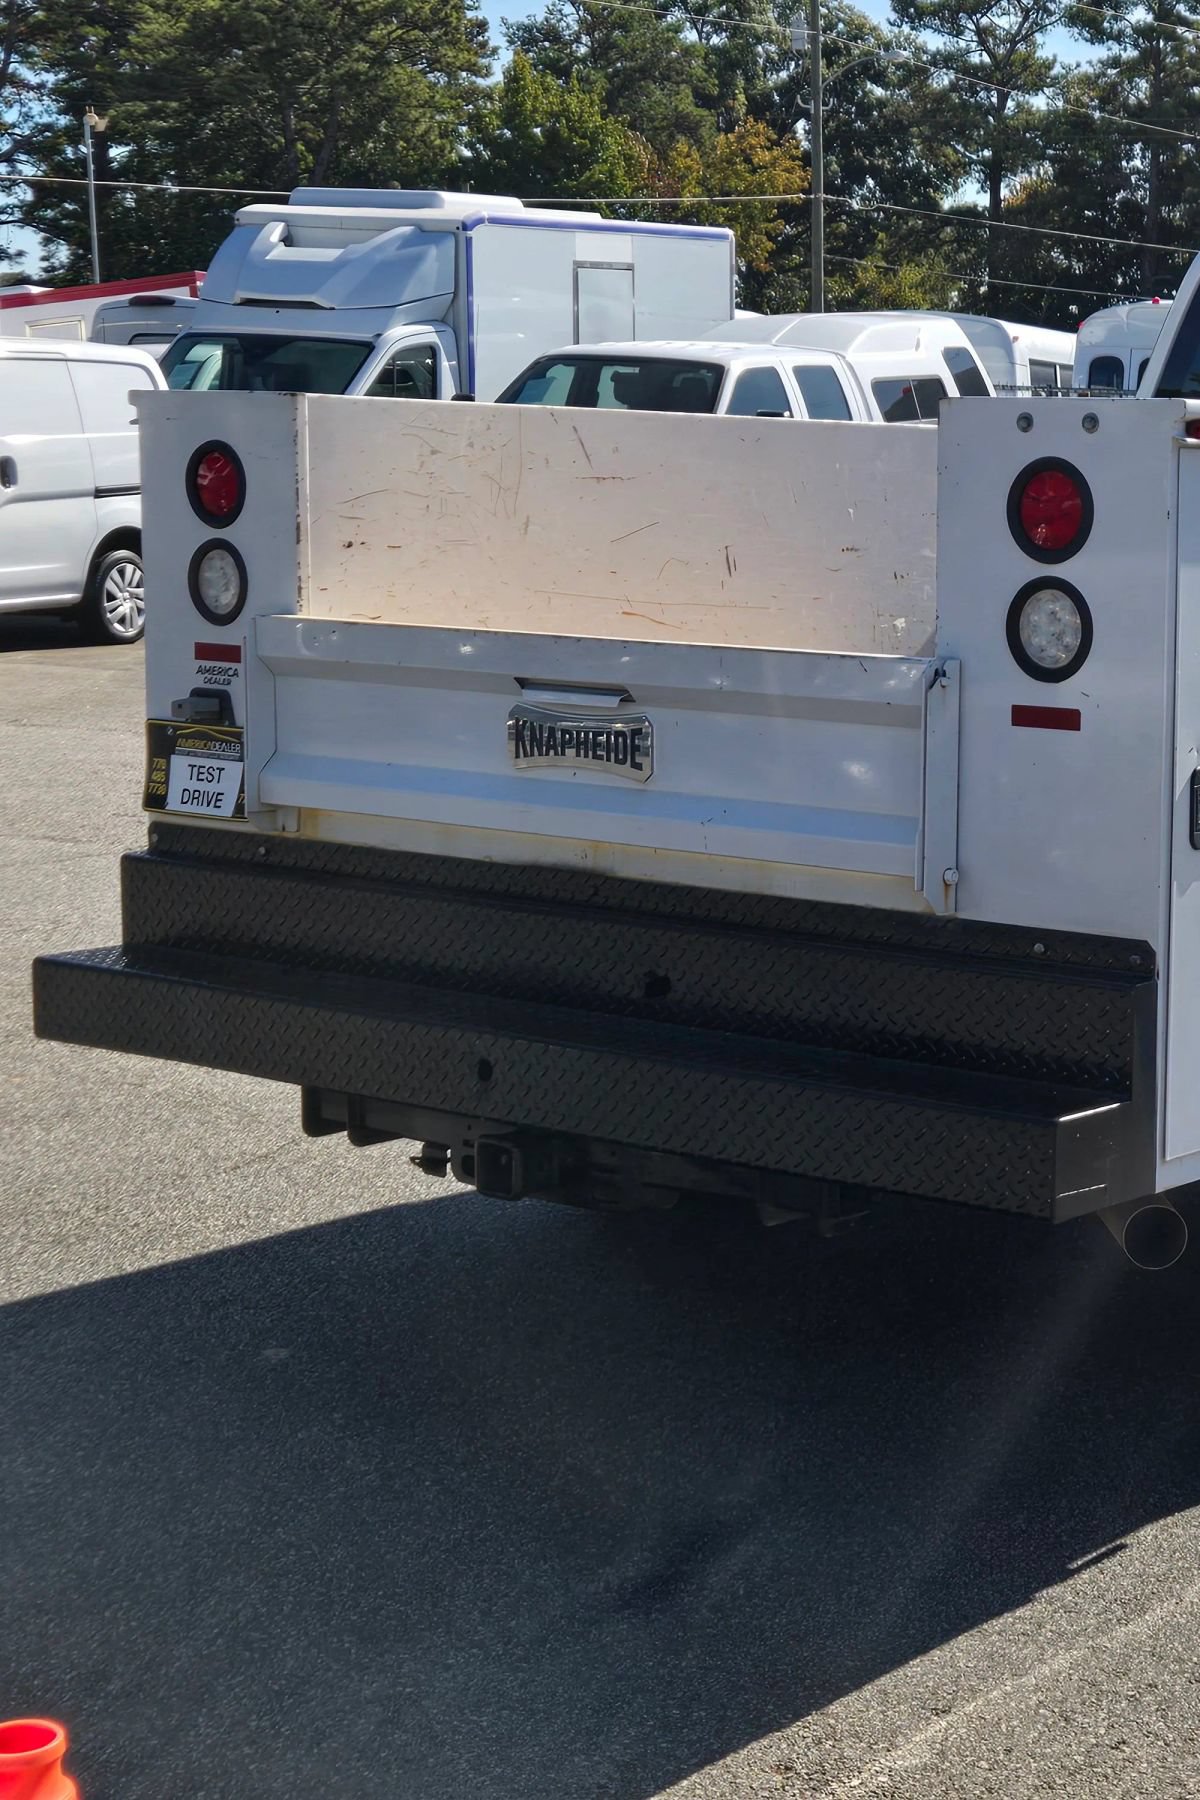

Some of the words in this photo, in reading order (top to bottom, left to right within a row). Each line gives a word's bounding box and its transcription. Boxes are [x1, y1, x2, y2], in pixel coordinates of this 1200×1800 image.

[195, 665, 239, 678] AMERICA
[203, 676, 232, 686] DEALER
[514, 715, 643, 771] KNAPHEIDE
[188, 764, 225, 784] TEST
[180, 788, 224, 808] DRIVE
